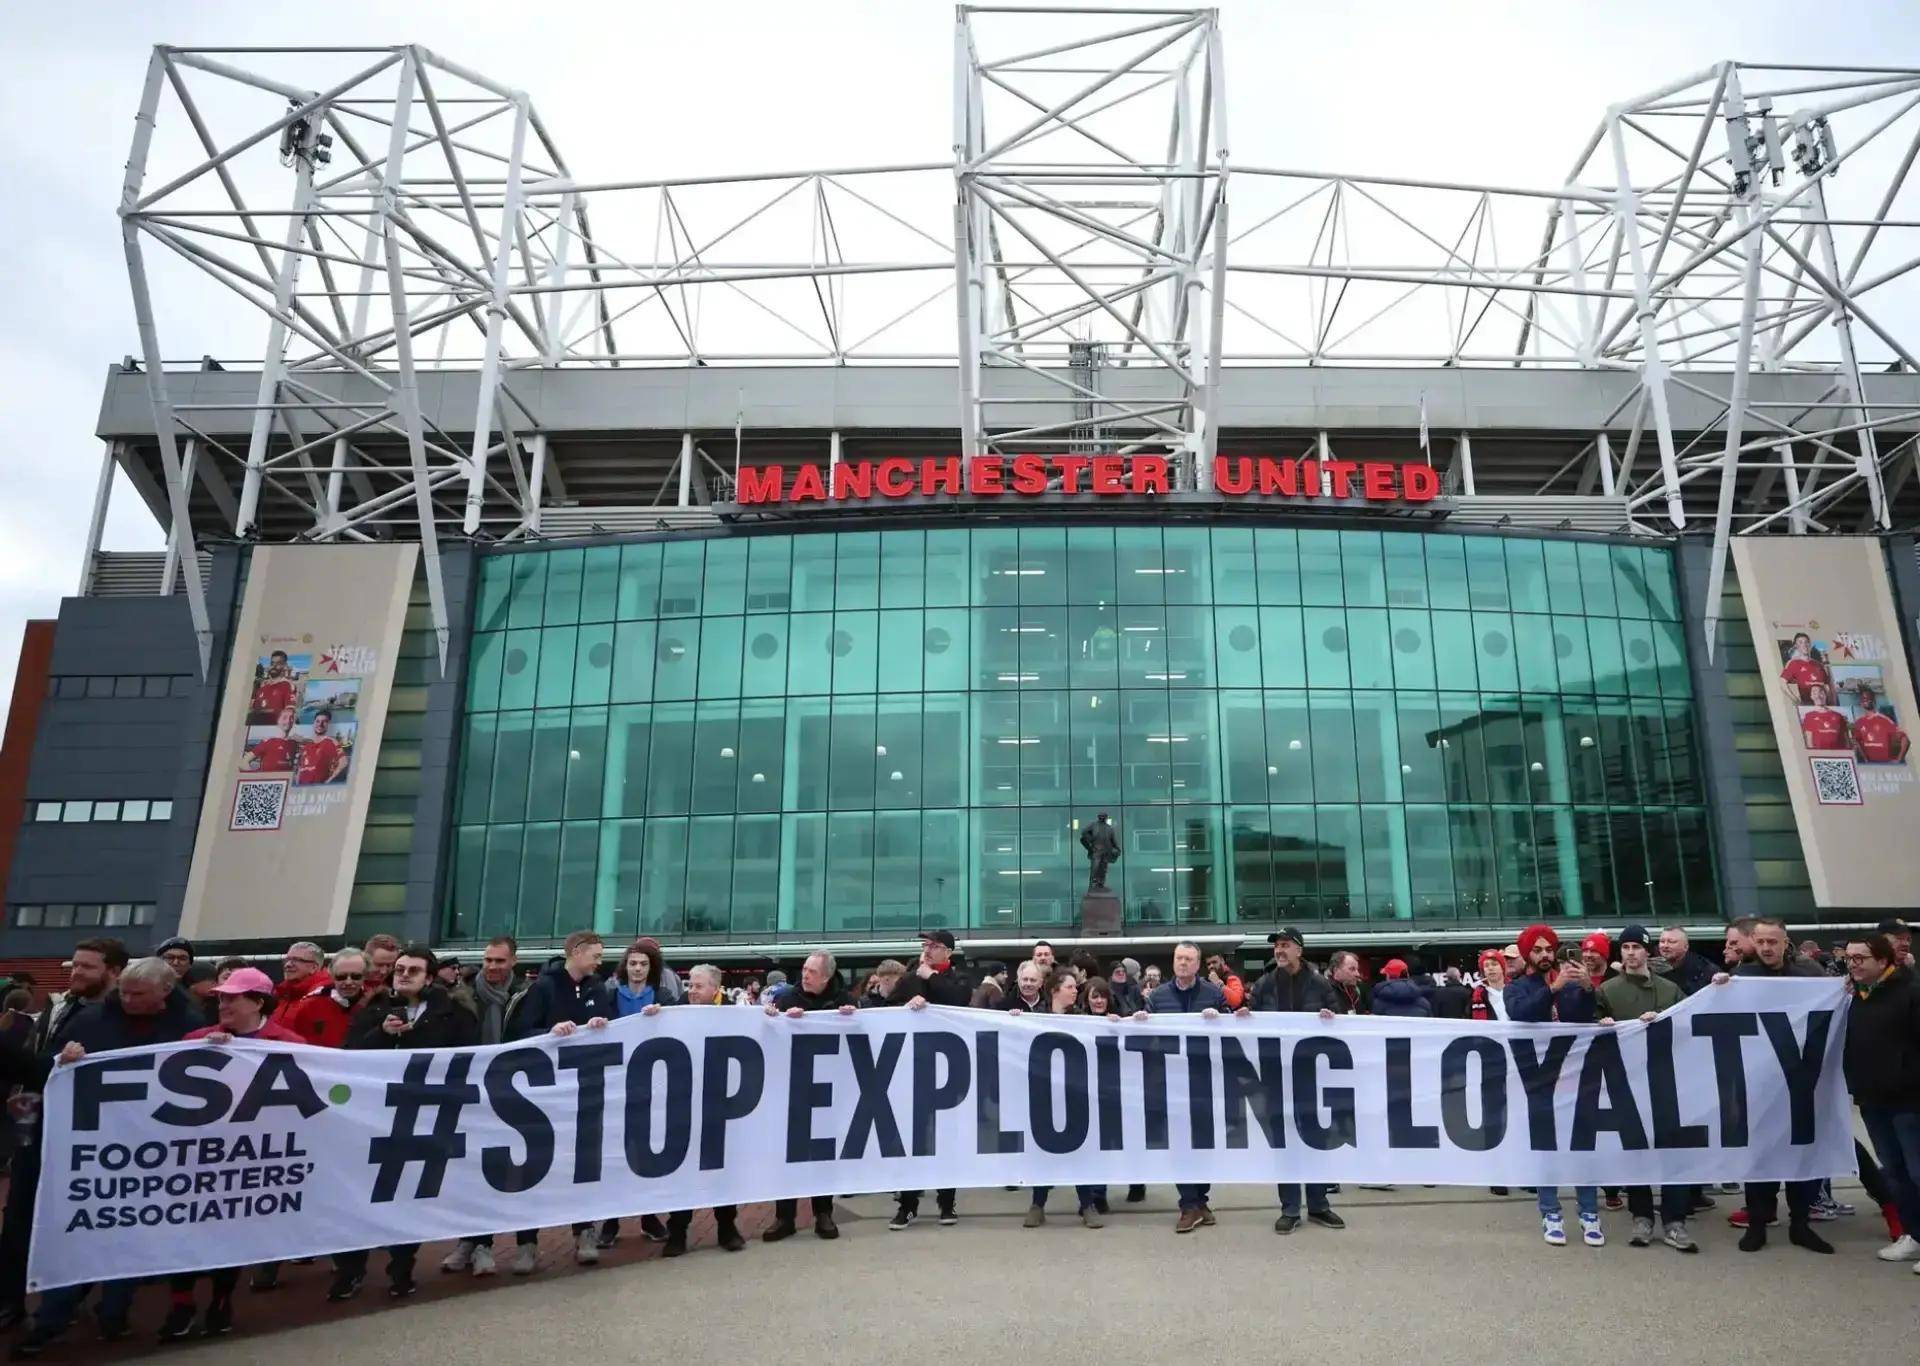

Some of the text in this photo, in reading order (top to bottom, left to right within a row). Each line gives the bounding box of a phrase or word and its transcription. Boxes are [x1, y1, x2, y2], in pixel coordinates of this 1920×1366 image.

[736, 454, 1441, 503] MANCHESTER UNITED
[71, 1048, 330, 1132] FSA
[367, 1009, 1835, 1204] #STOP EXPLOITING LOYALTY
[70, 1131, 307, 1172] FOOTBALL
[67, 1161, 315, 1202] SUPPORTERS'
[64, 1190, 303, 1233] ASSOCIATION
